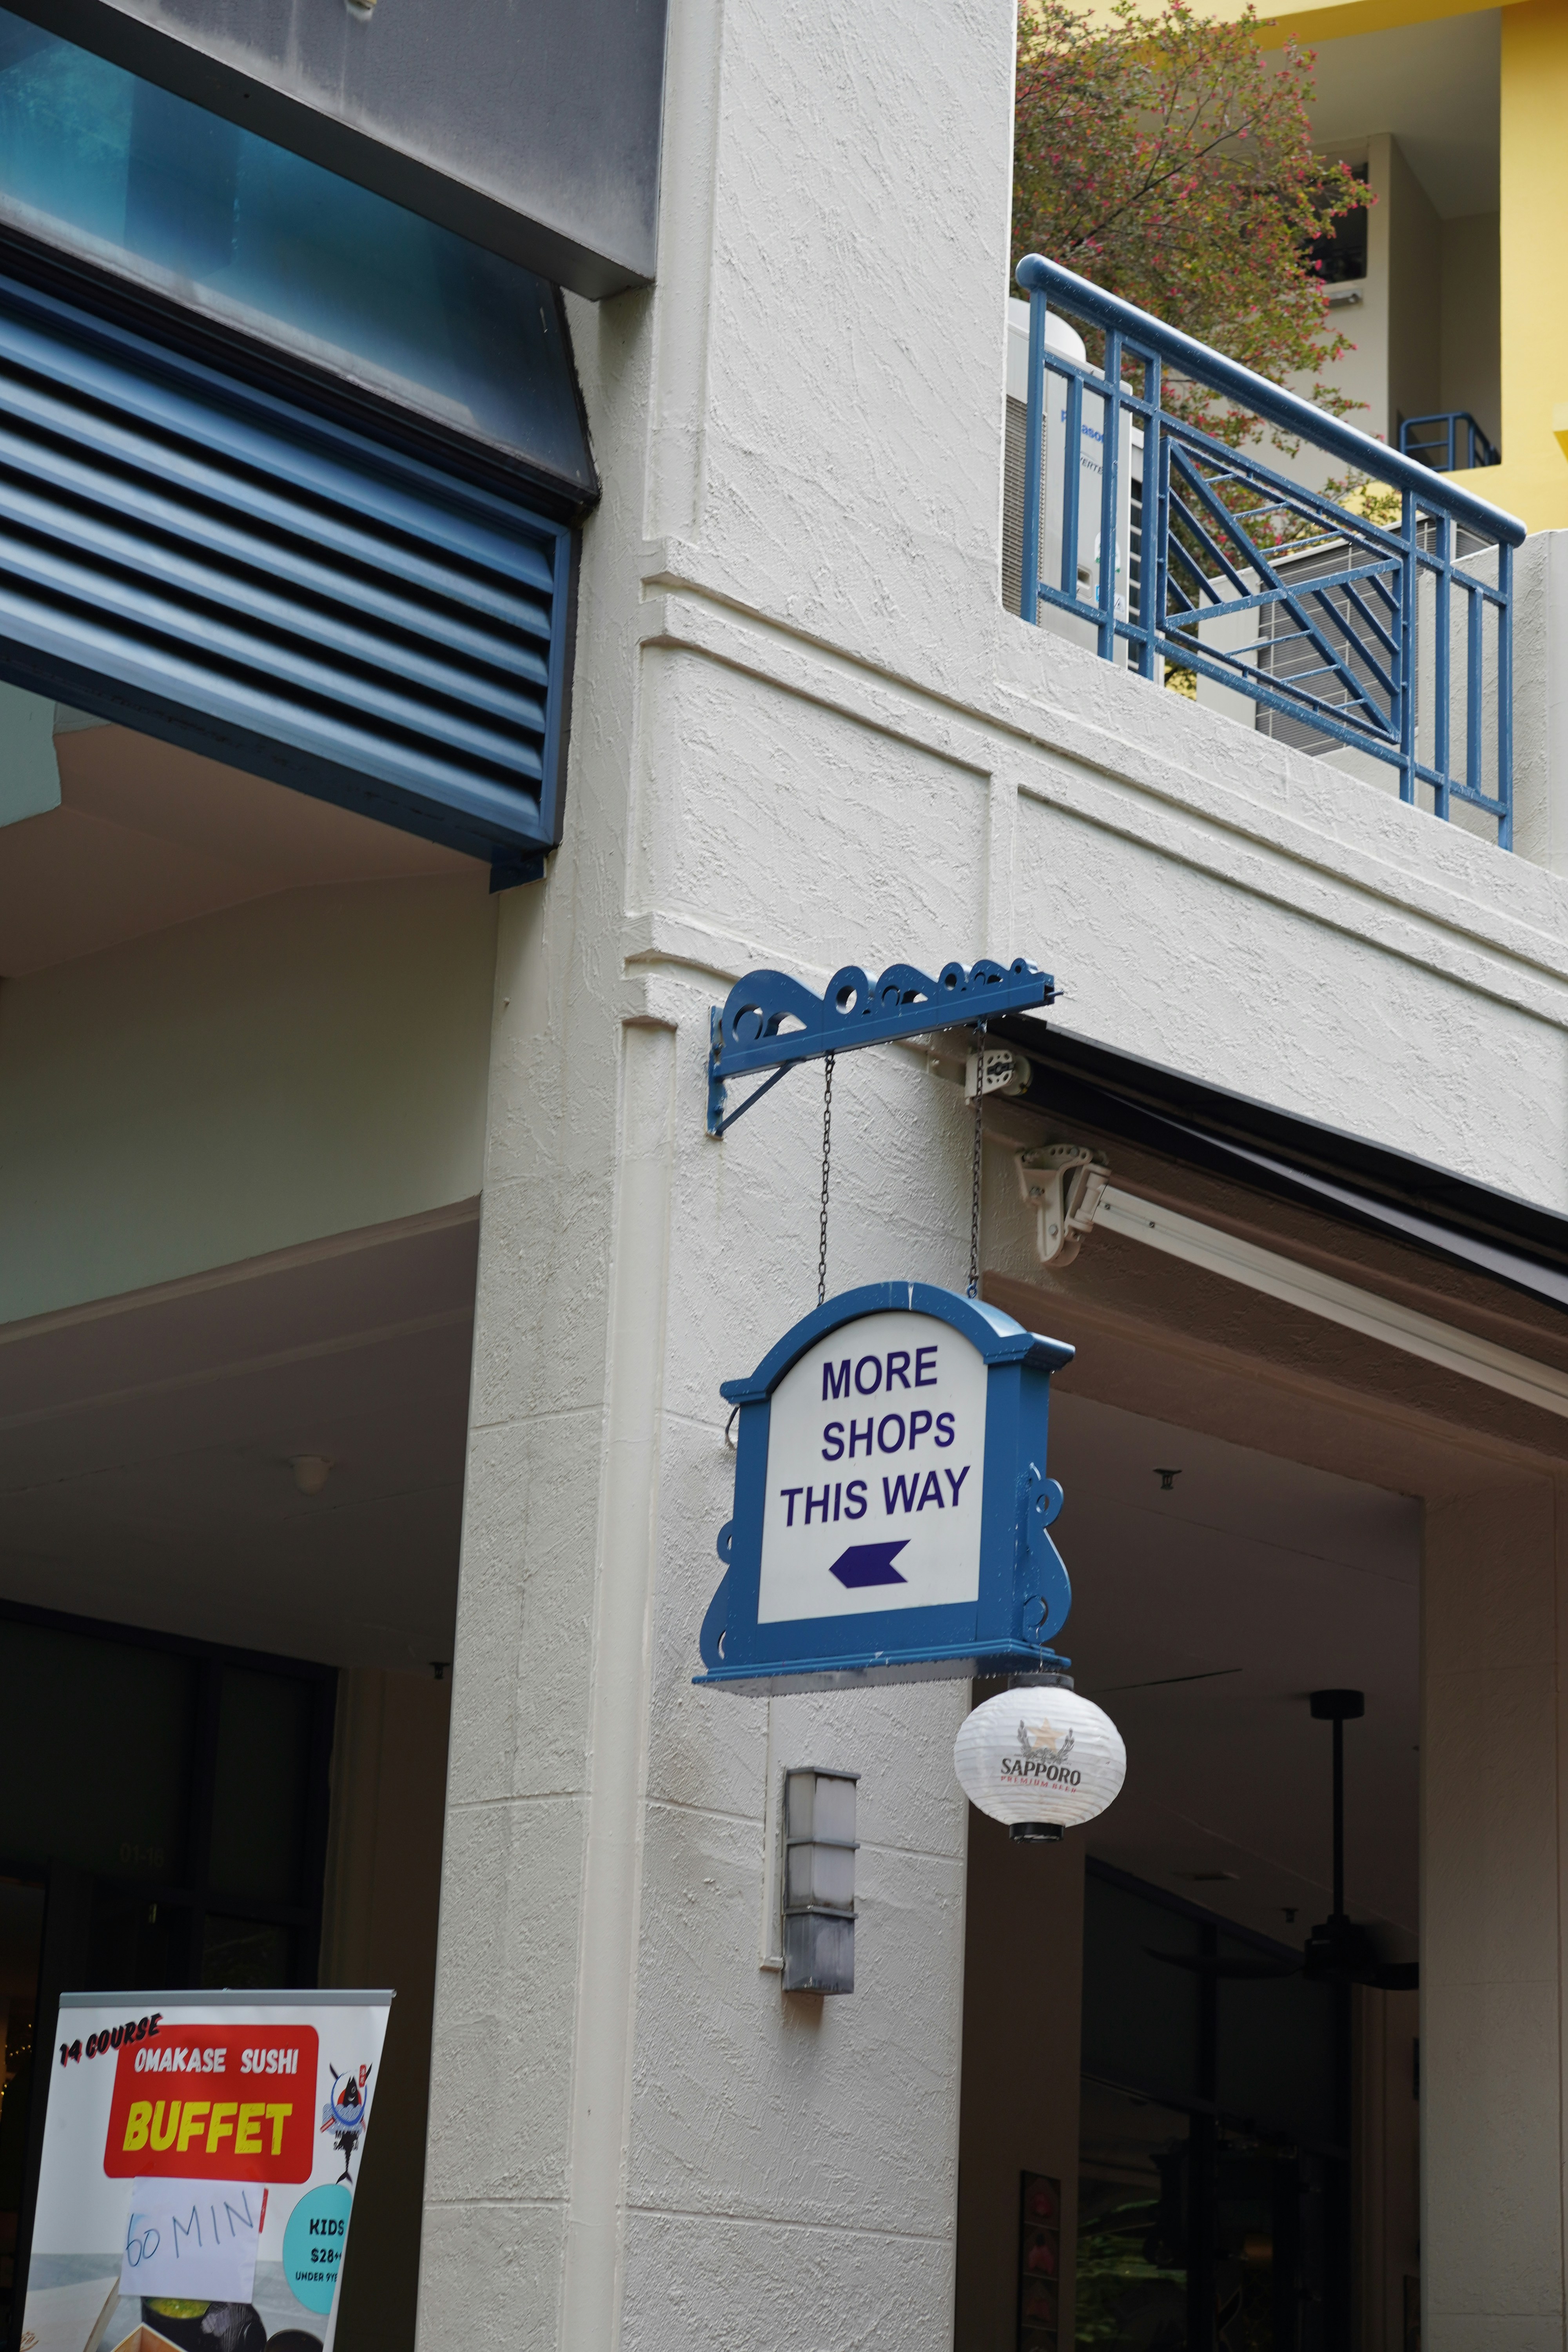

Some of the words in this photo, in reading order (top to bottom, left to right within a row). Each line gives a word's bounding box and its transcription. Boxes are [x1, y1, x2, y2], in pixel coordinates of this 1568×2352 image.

[822, 1345, 938, 1401] MORE
[822, 1410, 955, 1461] SHOPS
[780, 1480, 867, 1527] THIS
[882, 1465, 971, 1515] WAY
[1000, 1776, 1049, 1788] PREMIUM
[1052, 1783, 1076, 1793] BEER
[1001, 1758, 1081, 1786] SAPPORO
[59, 2039, 83, 2068] 14
[85, 2012, 163, 2060] COURSE
[134, 2047, 227, 2073] OMAKASE
[240, 2048, 299, 2074] SUSHI
[122, 2100, 293, 2156] BUFFET
[125, 2213, 160, 2267] 60
[172, 2190, 254, 2259] MIN
[309, 2218, 345, 2236] KIDS
[296, 2271, 324, 2281] UNDER
